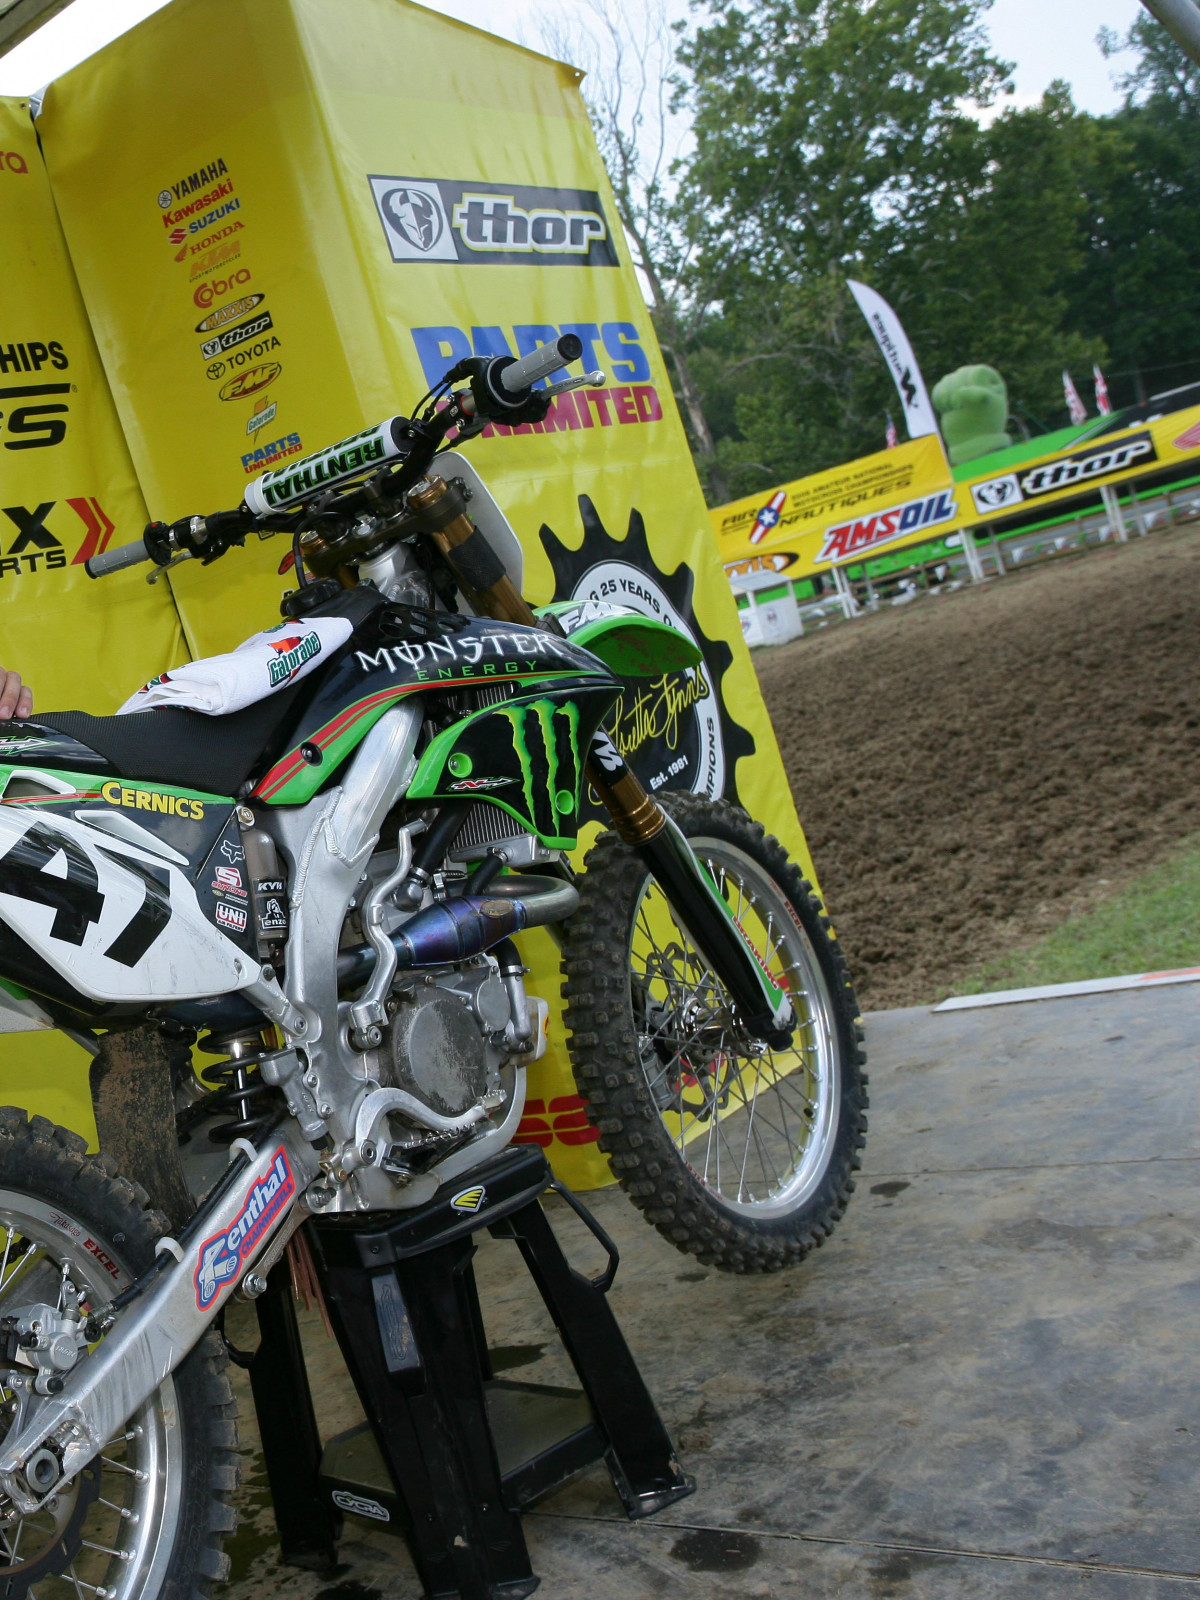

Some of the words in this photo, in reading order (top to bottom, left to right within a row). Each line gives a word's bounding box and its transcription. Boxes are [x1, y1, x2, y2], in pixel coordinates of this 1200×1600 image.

[171, 157, 228, 200] YAMAHA
[162, 178, 234, 229] Kawasaki
[188, 197, 241, 234] SUZUKI
[189, 220, 245, 255] HONDA
[455, 194, 607, 255] thor
[190, 240, 241, 278] KTM
[193, 268, 251, 309] Cobra
[205, 296, 255, 329] MAXXIS
[220, 317, 270, 347] thor
[227, 335, 281, 370] TOYOTA
[221, 364, 280, 399] FMF
[248, 406, 275, 432] Gatorade
[436, 386, 663, 440] MITED
[240, 432, 301, 468] PARTS
[244, 443, 303, 475] UNLIMITED
[1023, 441, 1151, 493] thor
[263, 435, 386, 508] RENTHAL
[722, 508, 757, 527] AIR
[779, 480, 912, 528] NAUTIQUES
[823, 489, 956, 559] AMSOIL
[599, 579, 617, 597] 25
[619, 578, 661, 614] YEARS
[269, 634, 319, 683] Gatorade
[356, 632, 564, 674] MONSTER
[416, 660, 538, 682] ENERGY
[650, 772, 668, 791] Est.
[668, 755, 689, 776] 1981
[101, 780, 204, 820] CERNIC'S
[217, 904, 246, 926] UNI
[264, 918, 287, 926] enzo
[783, 900, 803, 931] EXCEL
[241, 1181, 293, 1256] CHAINWHEELS
[83, 1237, 121, 1280] EXCEL
